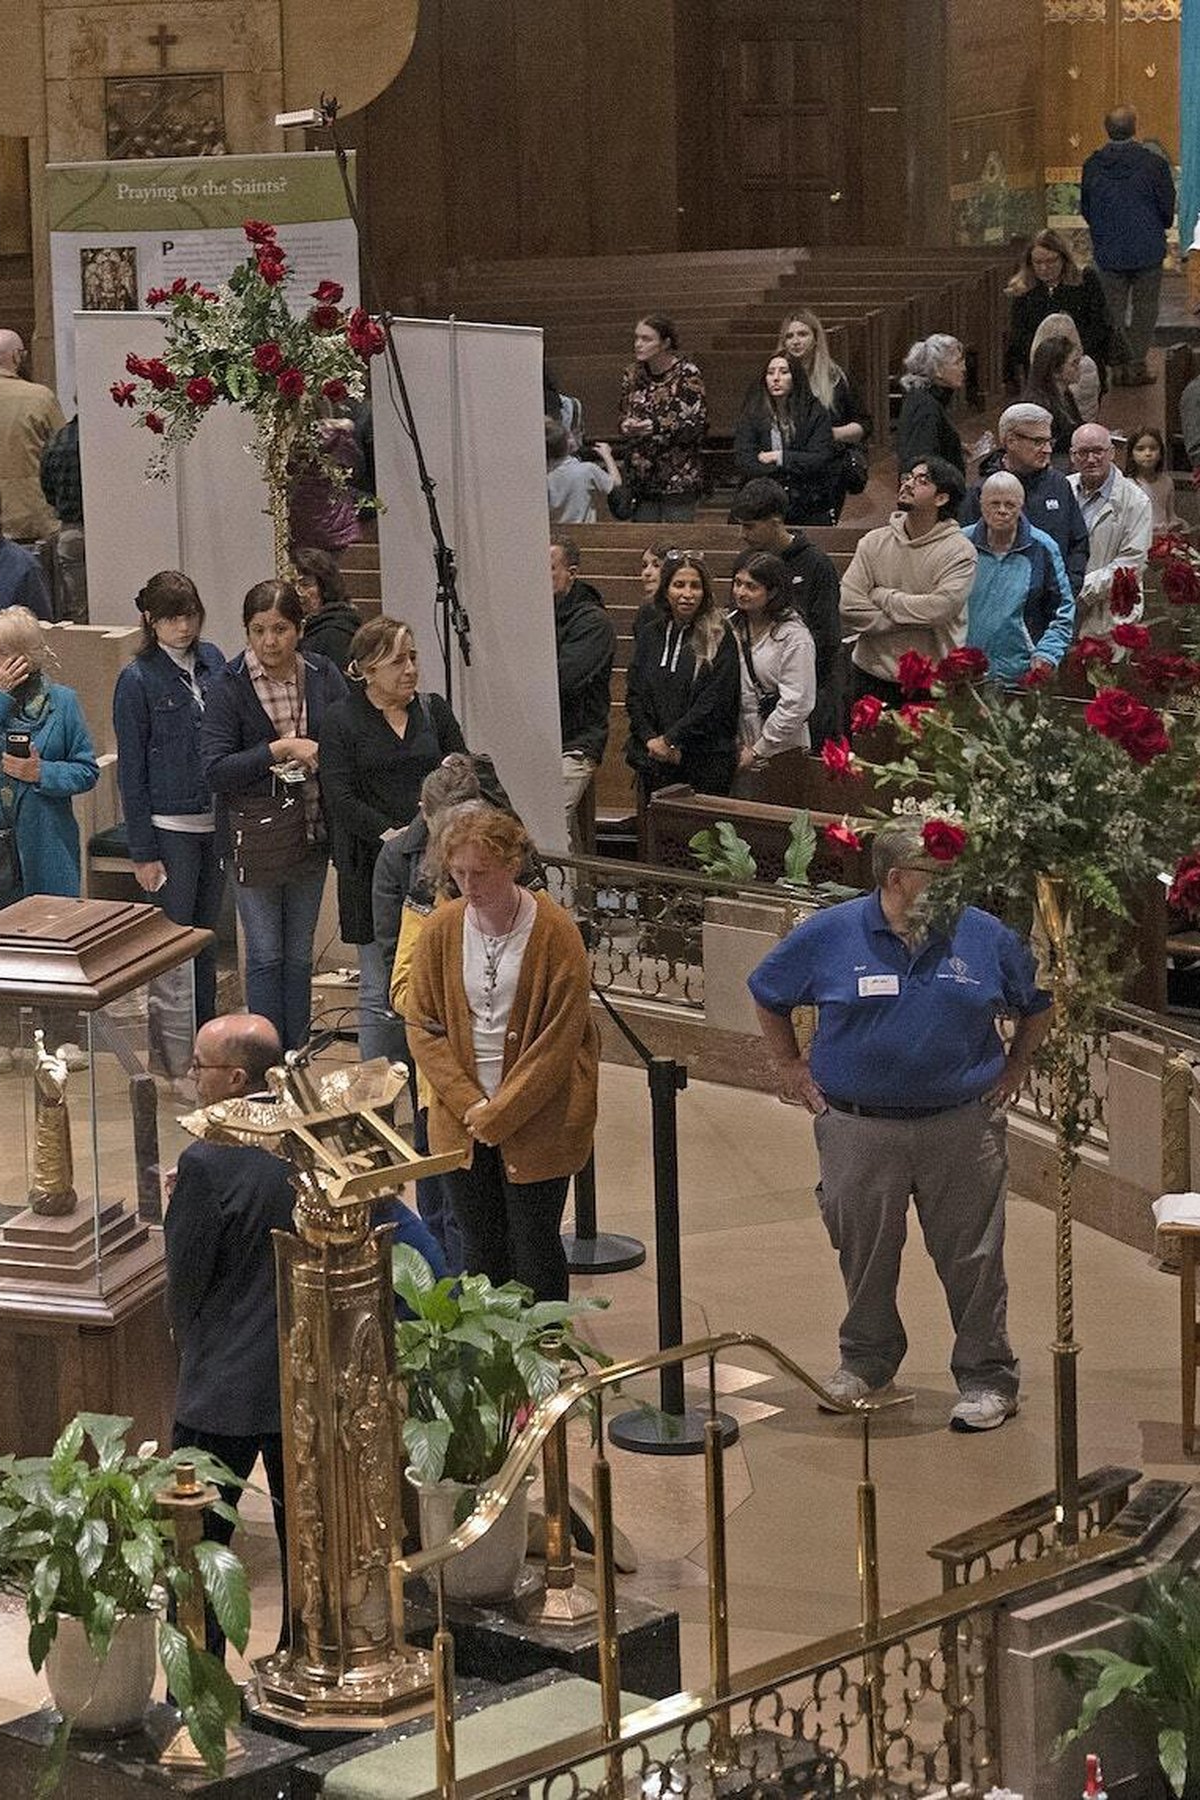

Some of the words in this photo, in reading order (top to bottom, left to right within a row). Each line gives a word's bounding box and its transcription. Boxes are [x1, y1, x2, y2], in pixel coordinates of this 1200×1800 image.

[117, 182, 178, 203] Praying
[181, 184, 198, 197] to
[202, 180, 227, 196] the
[231, 177, 288, 195] Saints?
